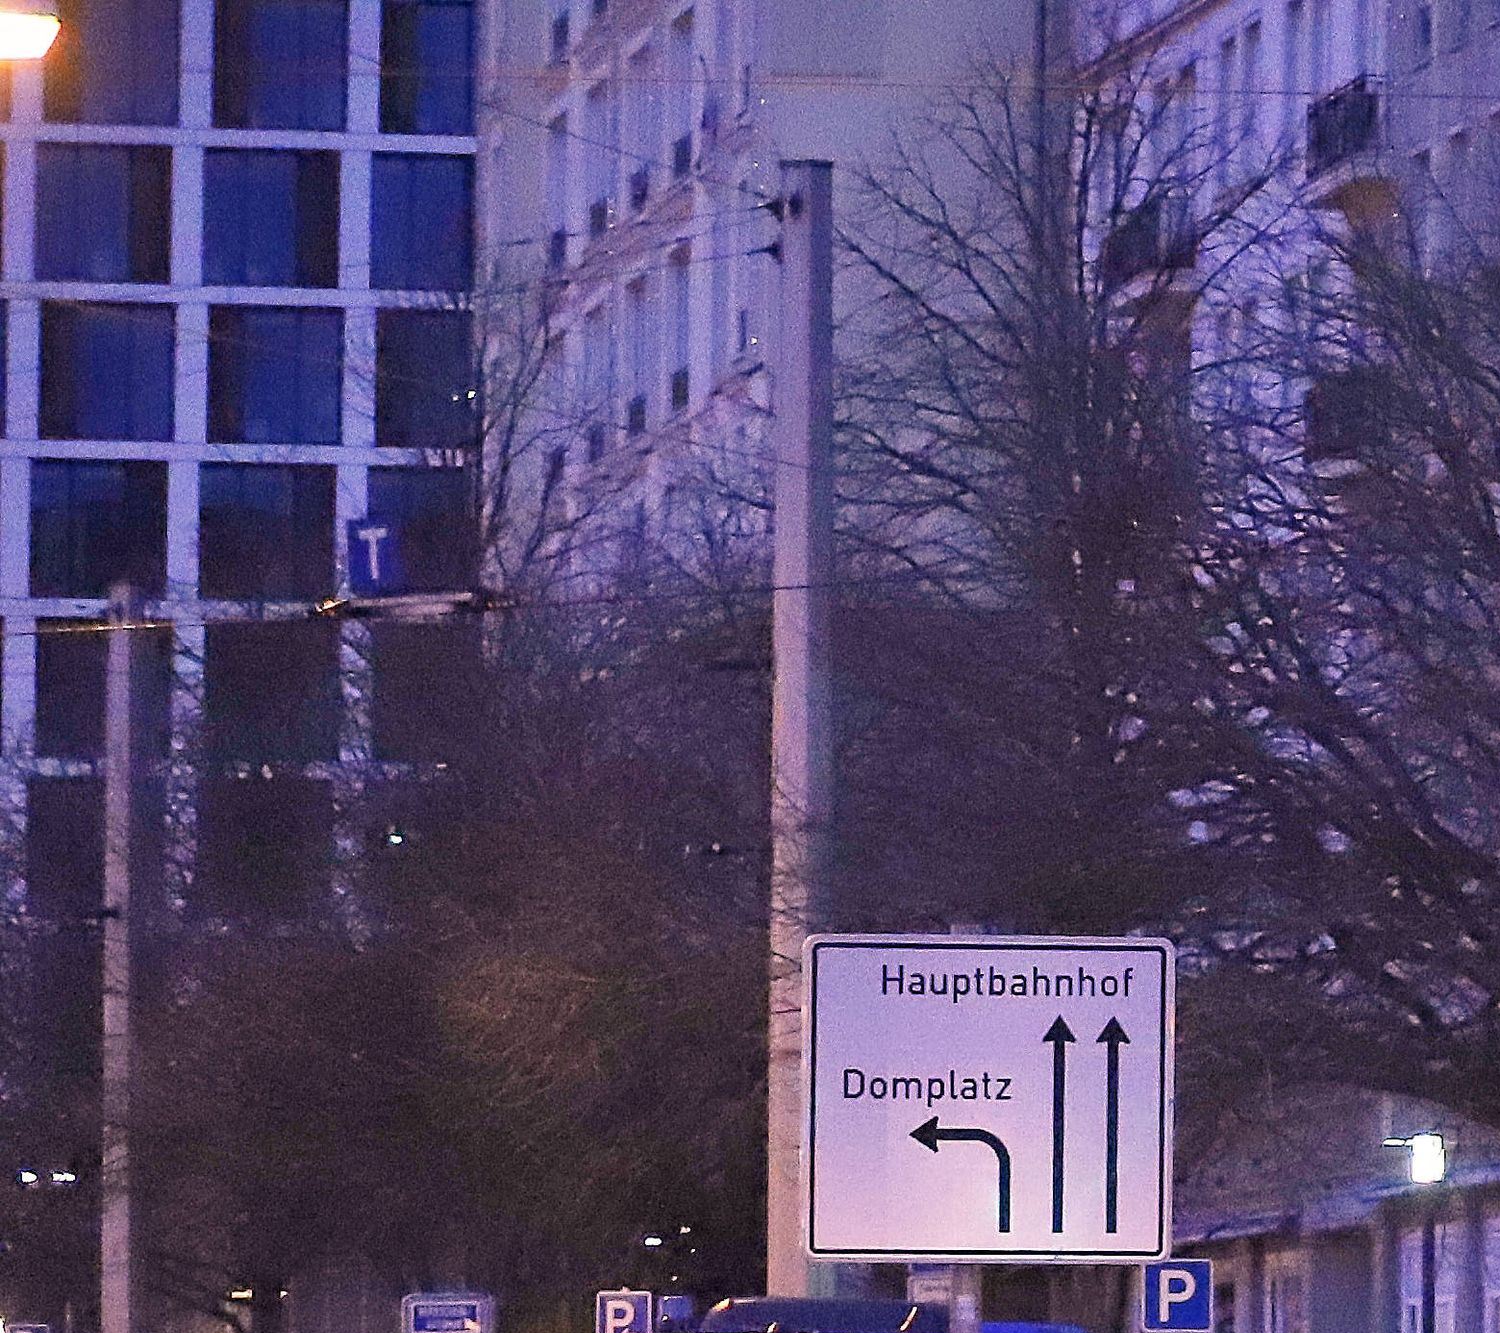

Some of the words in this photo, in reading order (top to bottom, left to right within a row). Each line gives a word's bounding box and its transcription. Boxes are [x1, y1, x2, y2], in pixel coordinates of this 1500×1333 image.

[882, 964, 1135, 1003] Hauptbahnhof
[843, 1068, 1013, 1108] Domplatz
[1159, 1269, 1196, 1323] P
